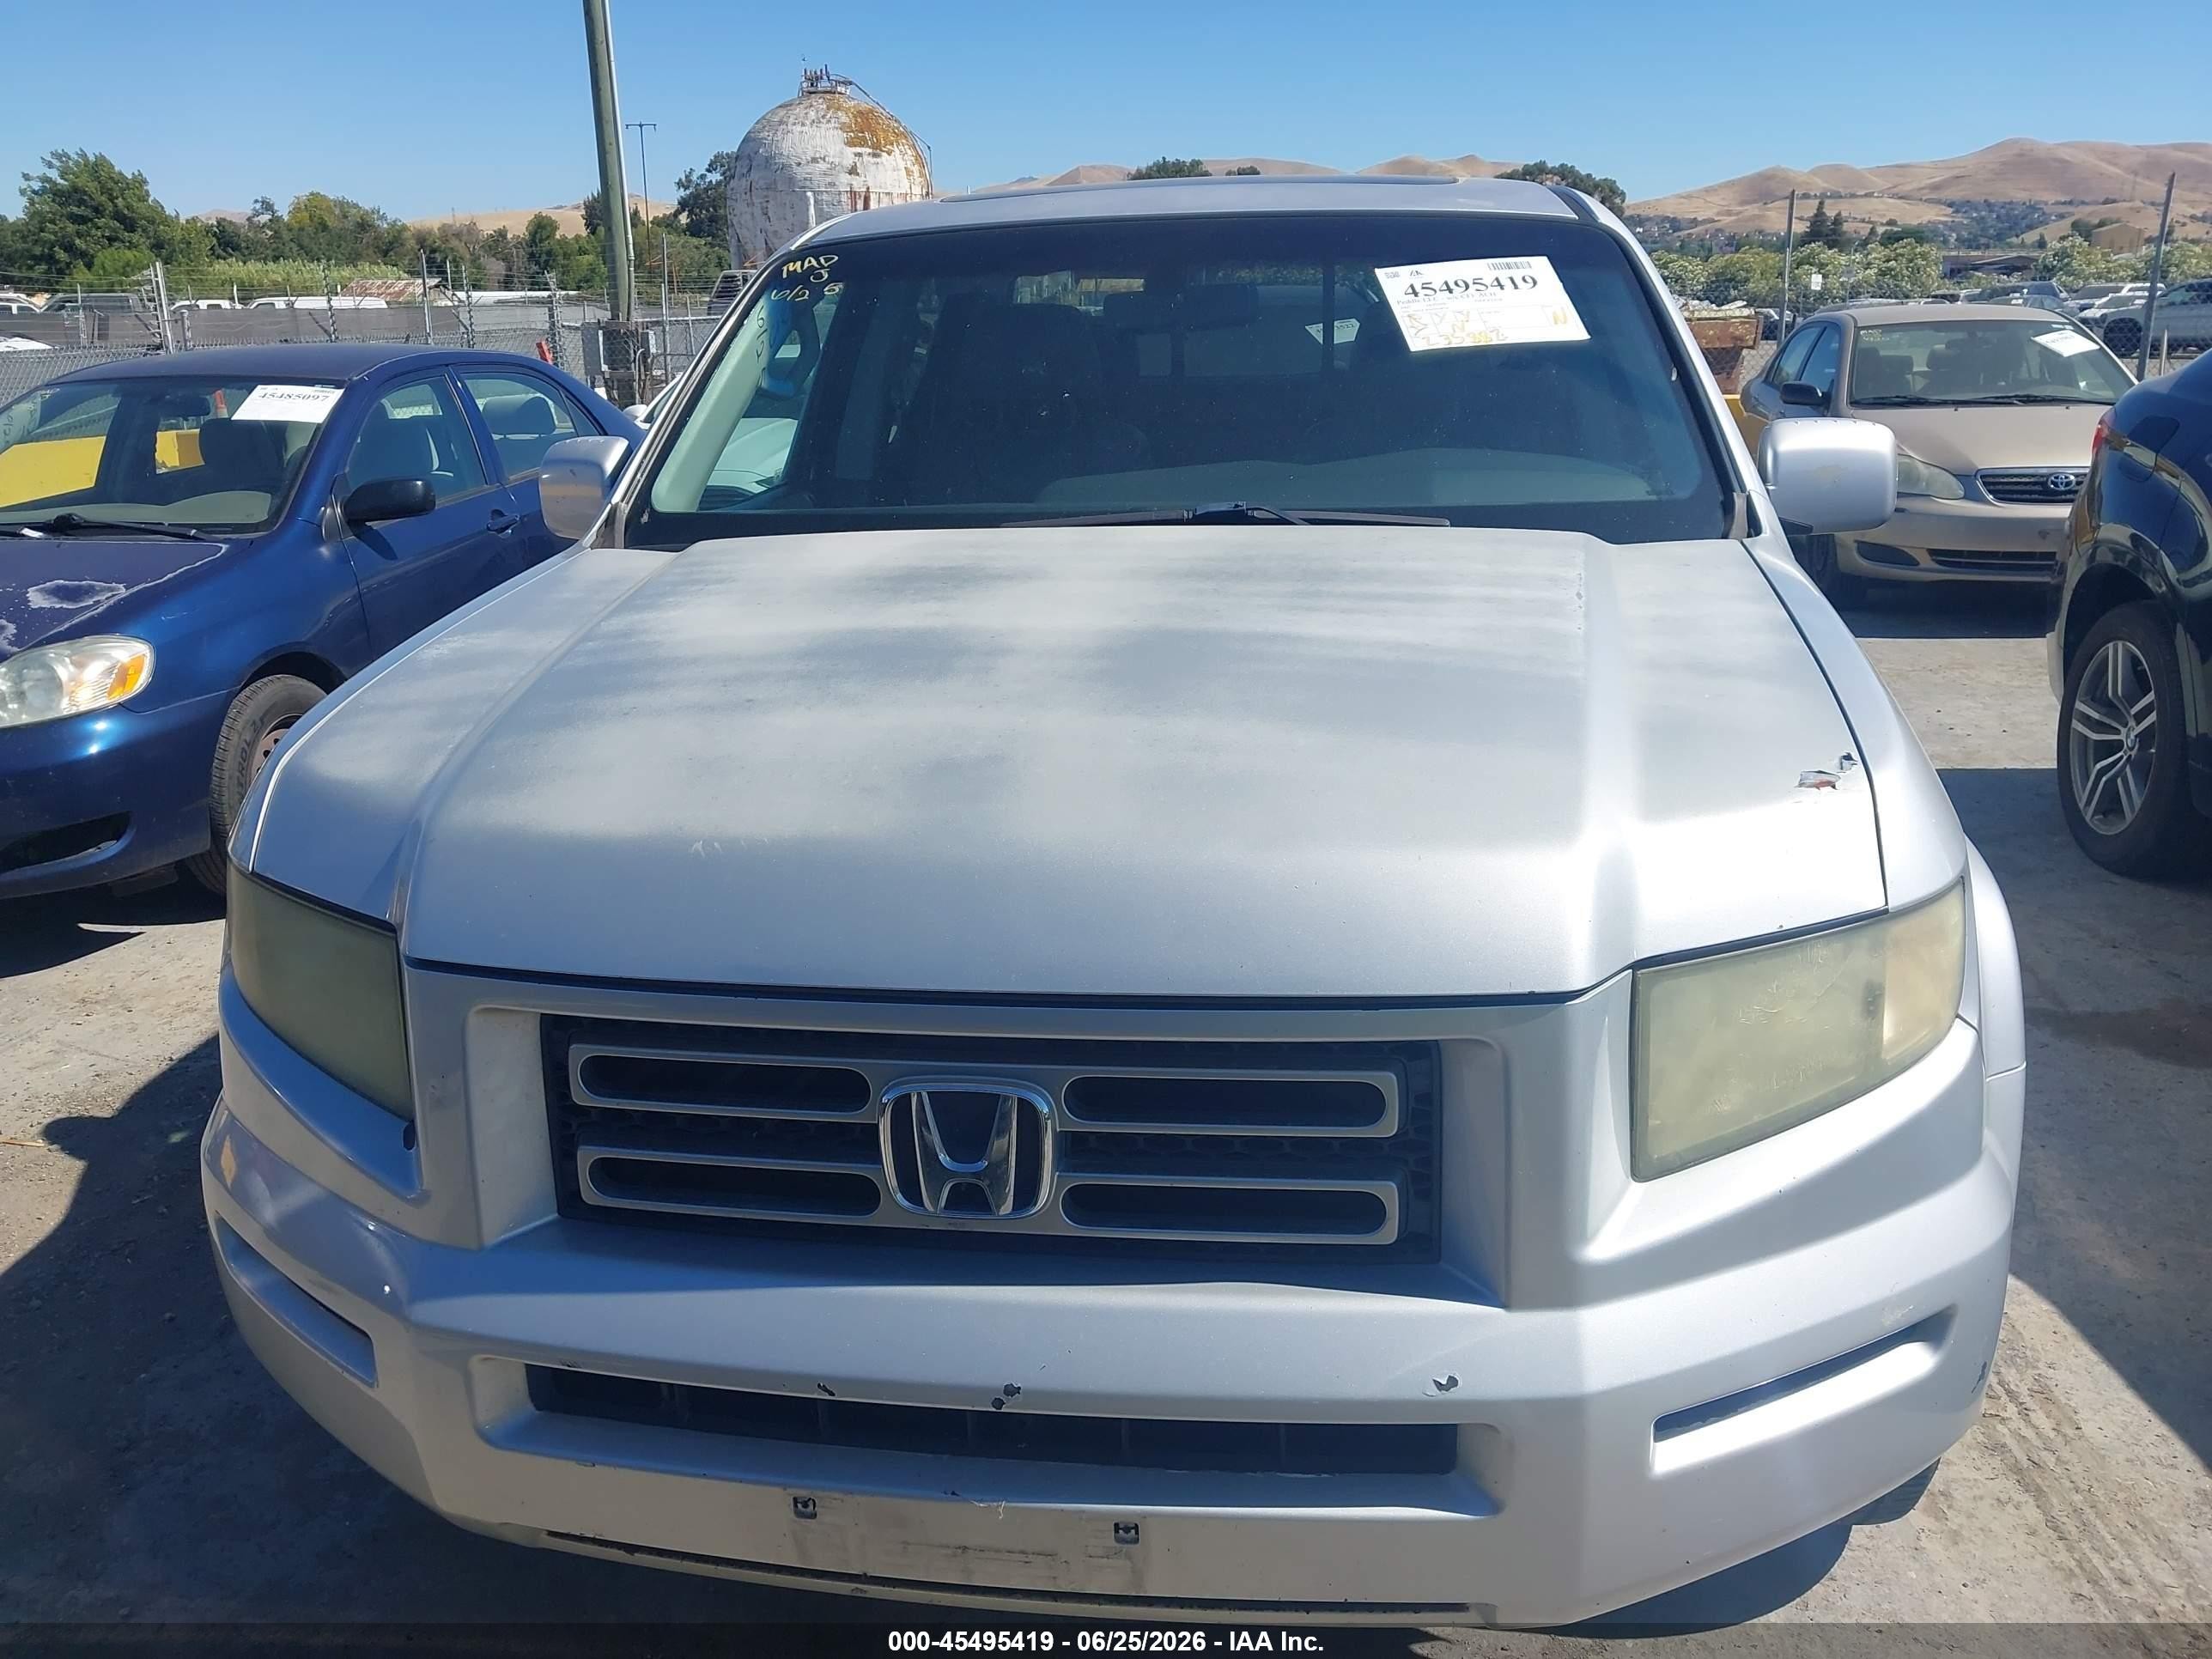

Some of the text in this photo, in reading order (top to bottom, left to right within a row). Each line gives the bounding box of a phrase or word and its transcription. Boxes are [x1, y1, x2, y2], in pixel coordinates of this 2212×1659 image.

[781, 254, 839, 279] MAD
[1404, 274, 1539, 298] 45495419
[258, 392, 330, 402] 45485097
